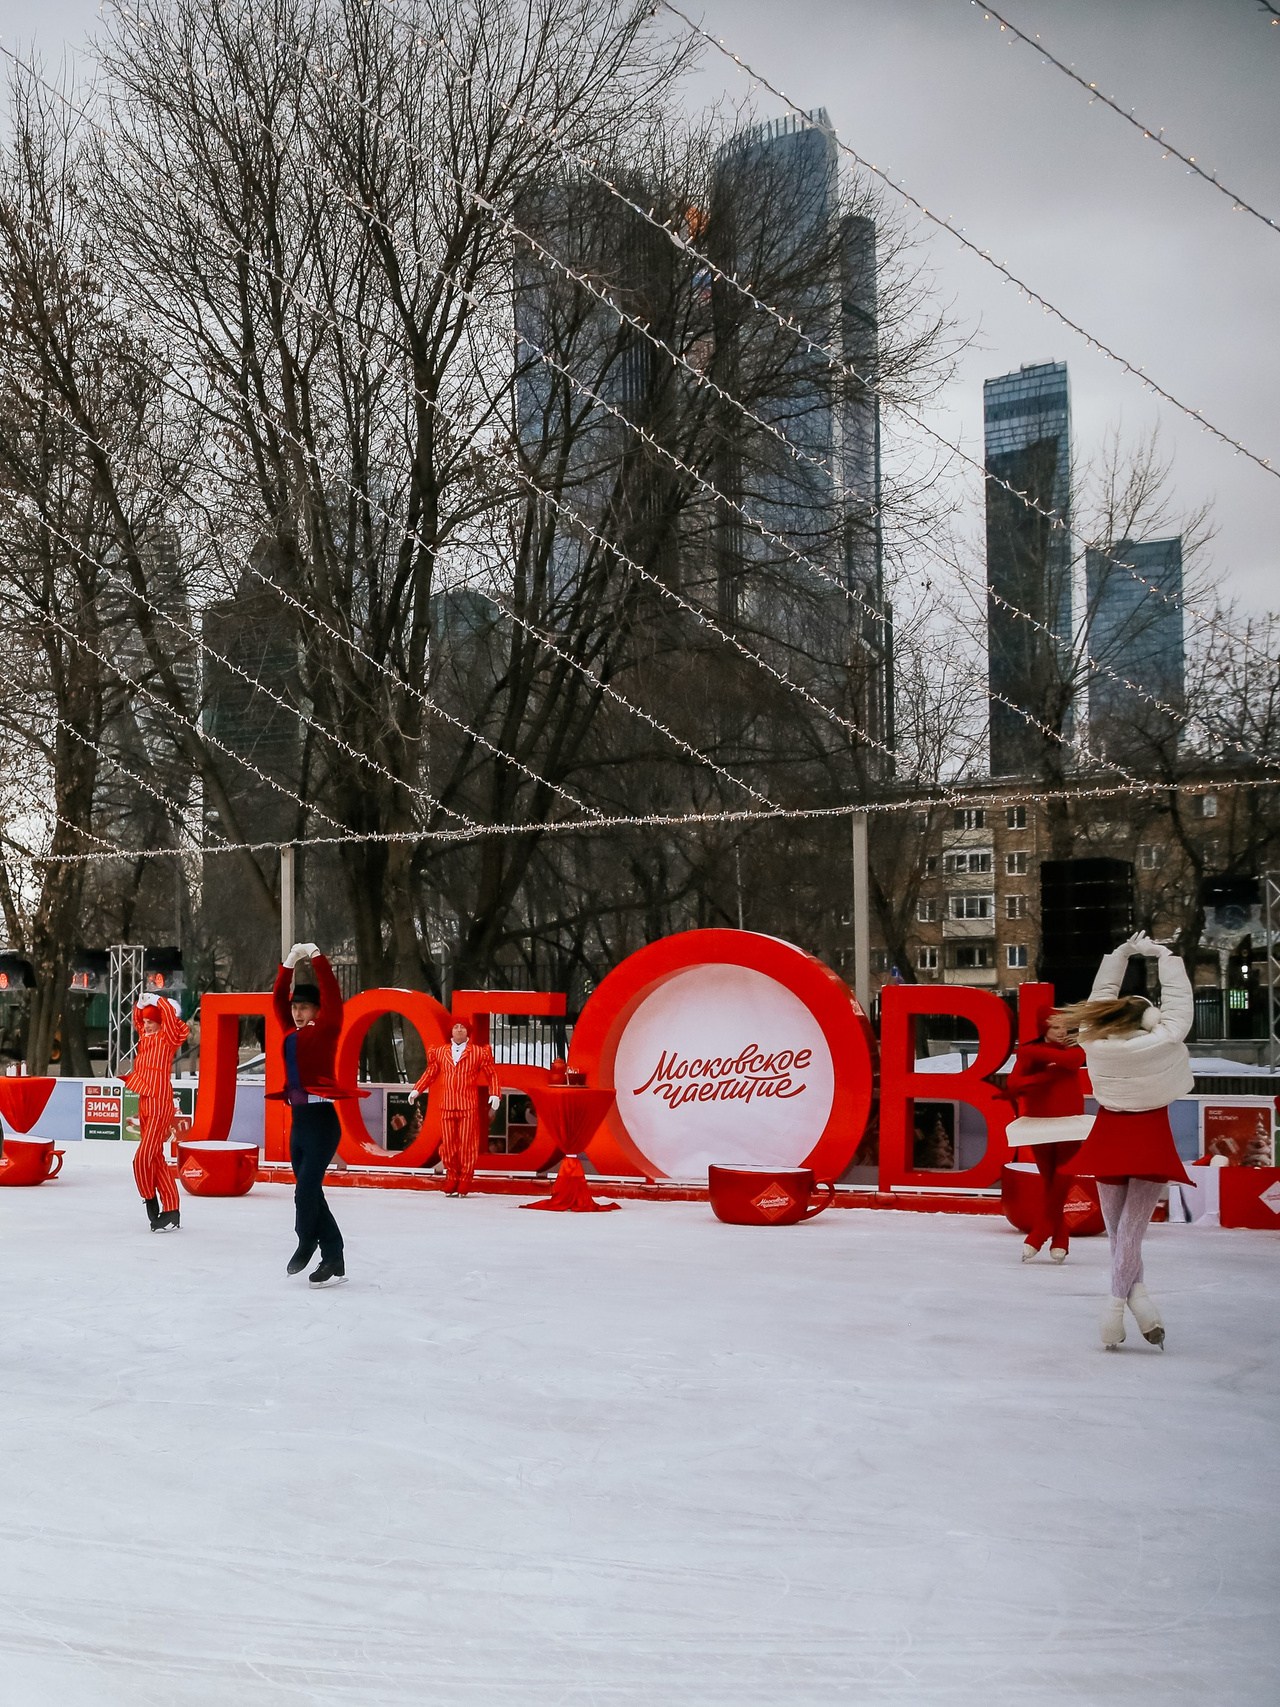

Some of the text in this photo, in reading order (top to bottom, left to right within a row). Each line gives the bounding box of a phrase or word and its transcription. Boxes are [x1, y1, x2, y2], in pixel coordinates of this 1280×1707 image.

[633, 1043, 812, 1095] Московское
[87, 1101, 119, 1112] ЗИМА
[653, 1071, 807, 1109] чаепитие
